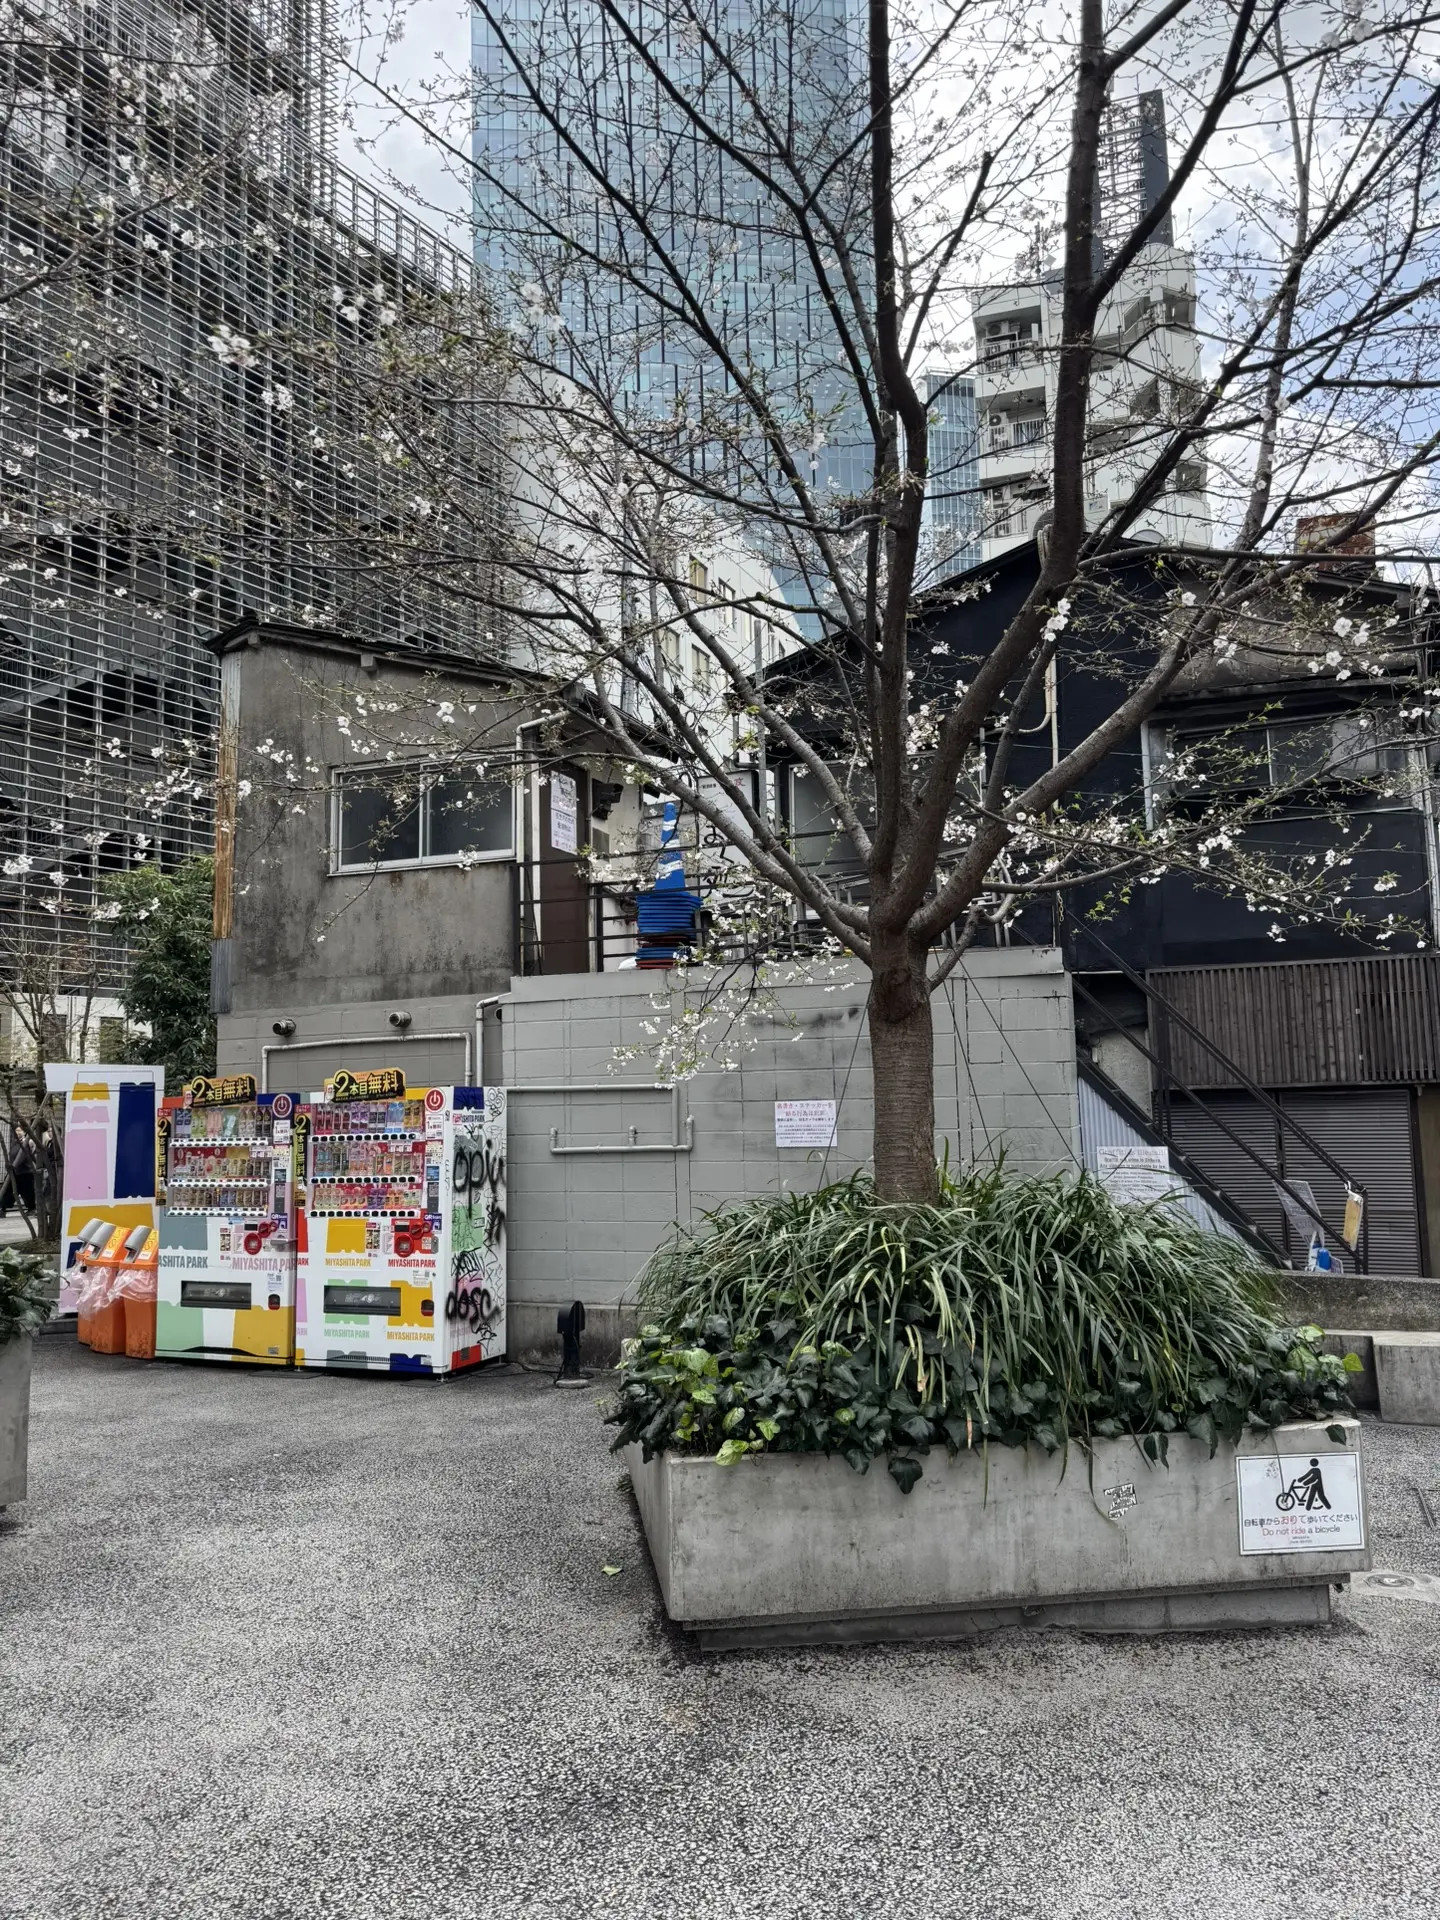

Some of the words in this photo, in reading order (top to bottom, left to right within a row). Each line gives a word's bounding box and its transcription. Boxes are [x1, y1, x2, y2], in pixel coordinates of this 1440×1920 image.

[334, 1070, 398, 1096] 2本目無料
[191, 1076, 251, 1102] 2本目無料
[186, 1256, 208, 1268] PARK
[232, 1257, 278, 1270] MIYASHITA
[325, 1258, 356, 1266] MIYASHITA
[356, 1259, 371, 1267] PARK
[388, 1259, 420, 1267] MIYASHITA
[420, 1260, 436, 1268] PARK
[324, 1329, 355, 1337] MIYASHITA
[355, 1330, 370, 1338] PARK
[387, 1332, 419, 1340] MIYASHITA
[419, 1333, 435, 1342] PARK
[1244, 1514, 1358, 1527] 自転車からおりて歩いてください
[1262, 1528, 1274, 1536] Do
[1276, 1527, 1289, 1535] not
[1291, 1526, 1306, 1534] ride
[1315, 1525, 1341, 1534] bicycle
